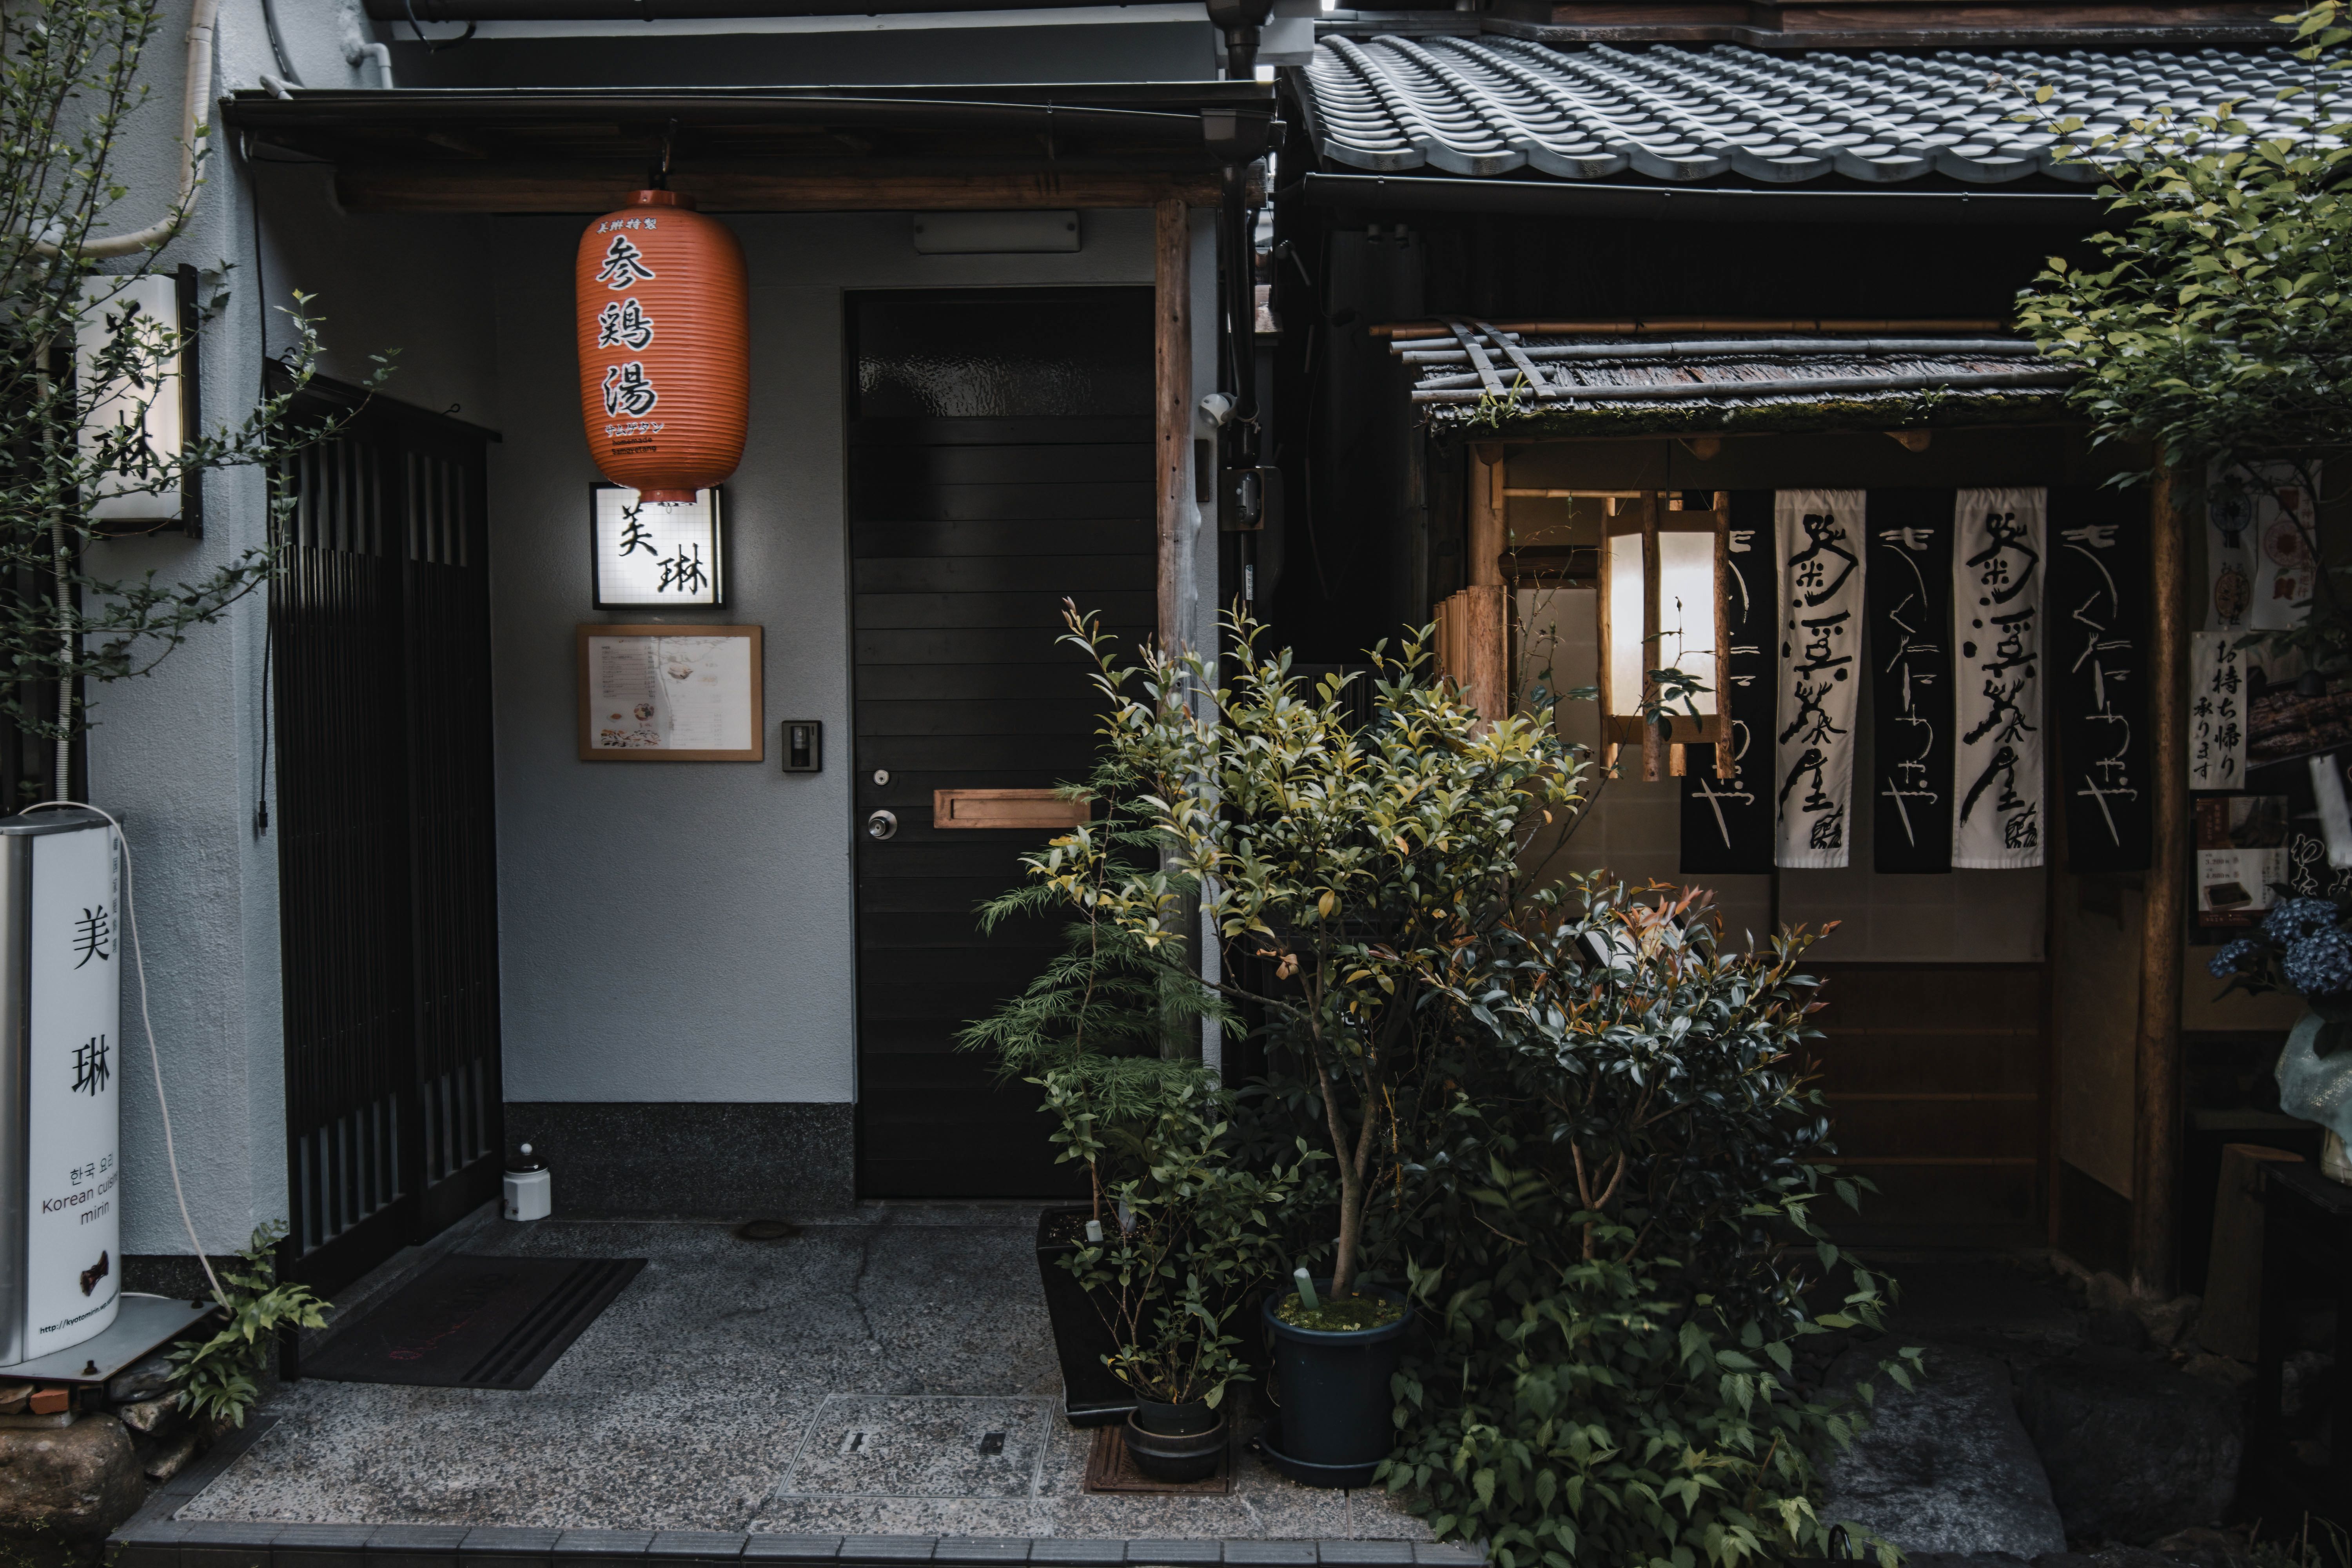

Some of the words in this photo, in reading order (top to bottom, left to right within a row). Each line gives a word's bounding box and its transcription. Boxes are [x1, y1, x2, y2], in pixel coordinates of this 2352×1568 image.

[596, 235, 658, 418] 参鶏湯
[605, 421, 665, 438] サムゲタン
[2194, 697, 2213, 780] 承ります
[2212, 640, 2242, 779] お持ち帰り
[71, 905, 110, 1097] 美琳
[70, 1163, 95, 1185] 한국
[100, 1151, 113, 1173] 요리
[42, 1189, 93, 1214] Korean
[81, 1201, 109, 1225] mirin
